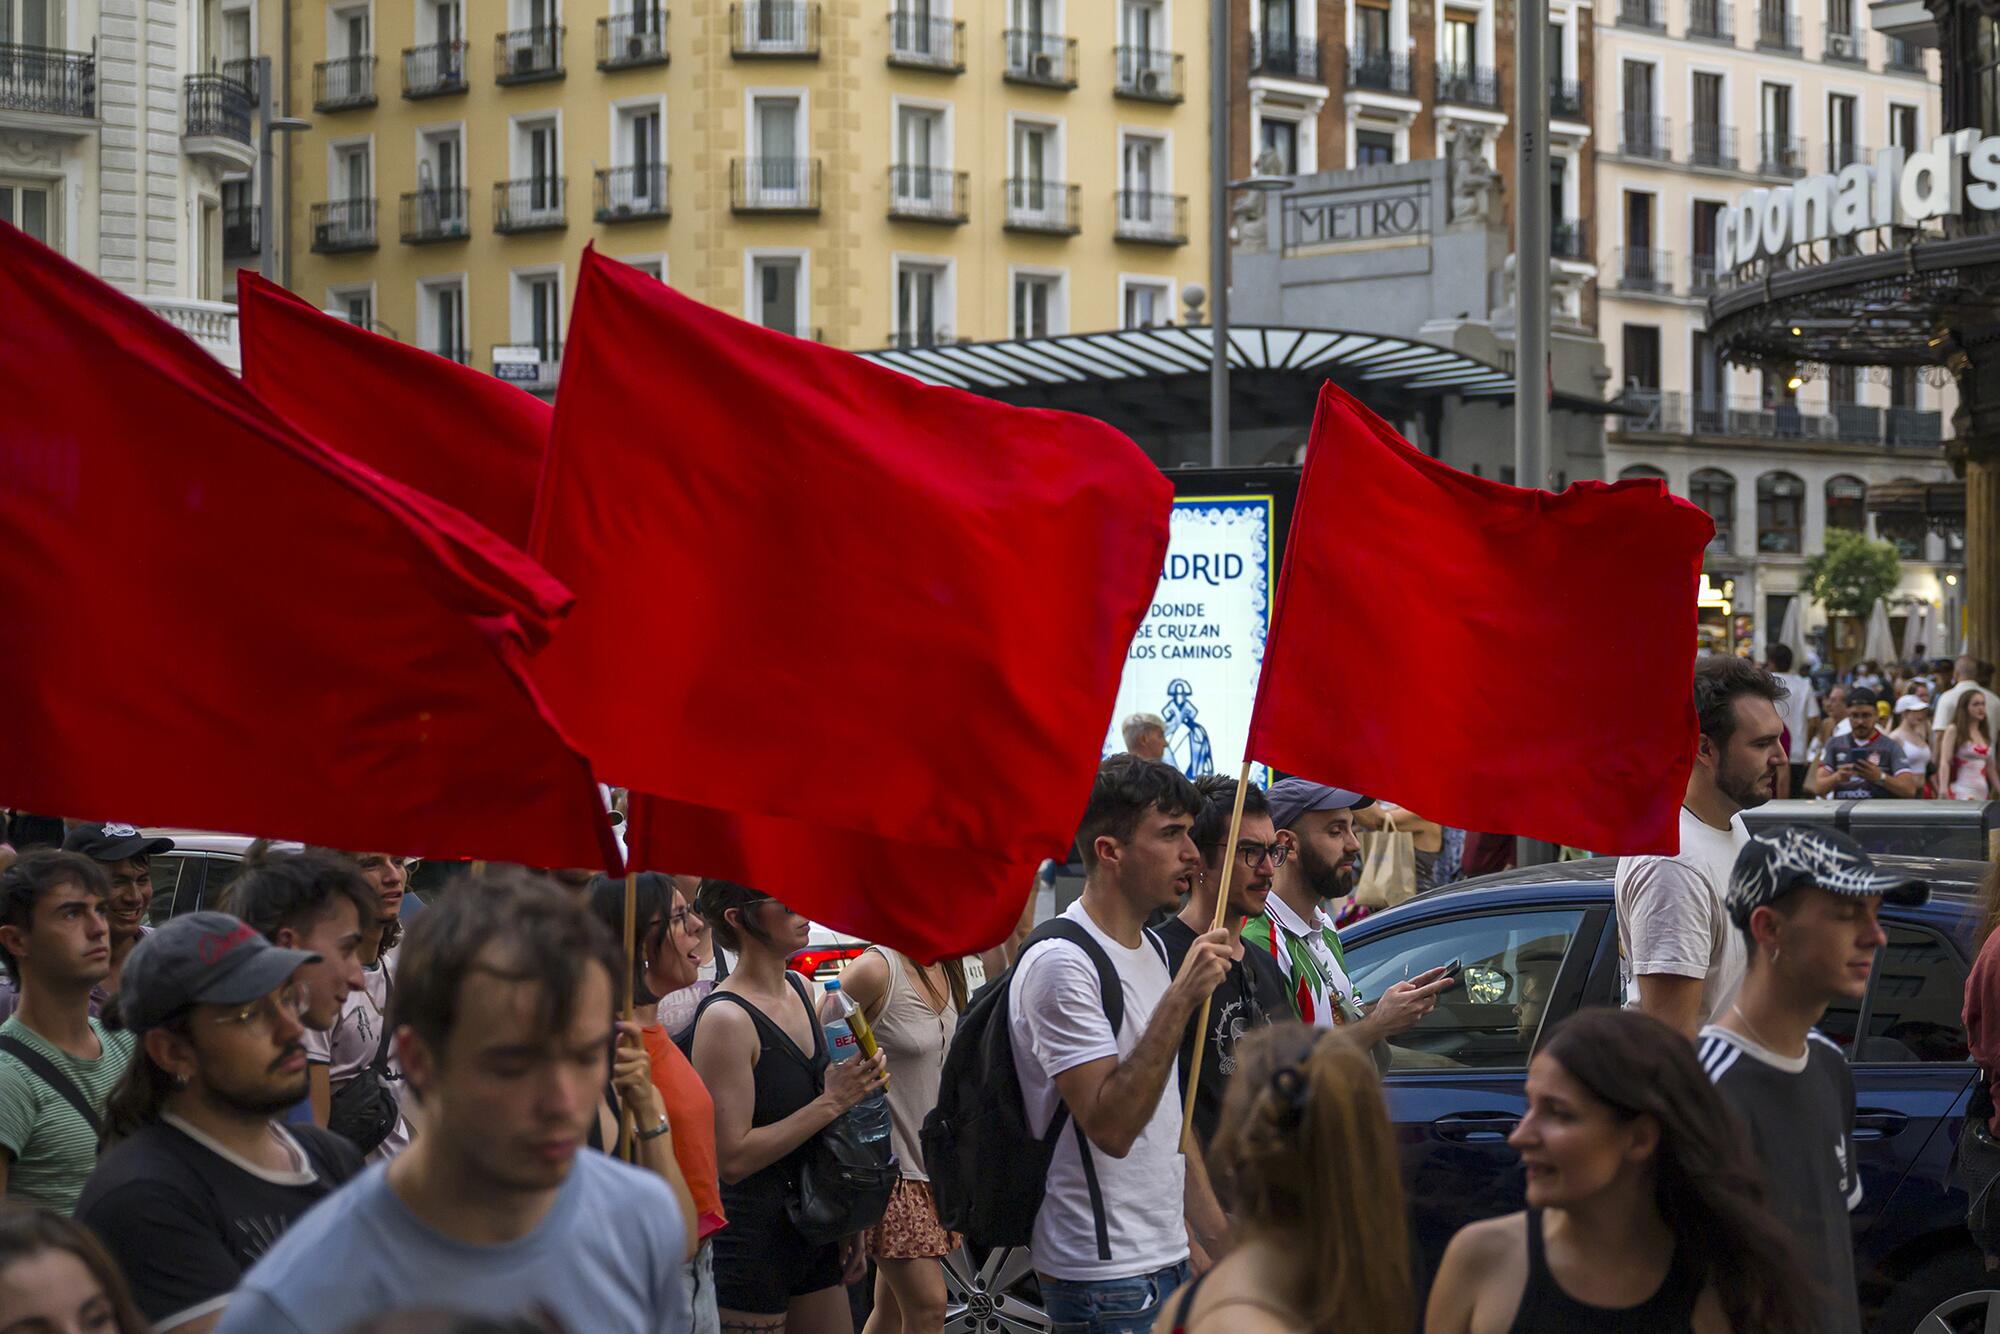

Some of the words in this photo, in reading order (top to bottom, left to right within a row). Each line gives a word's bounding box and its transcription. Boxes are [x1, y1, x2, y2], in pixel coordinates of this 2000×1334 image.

[1715, 127, 2000, 279] cDonald's
[1300, 199, 1419, 240] METRO
[1151, 603, 1205, 617] DONDE
[1137, 624, 1153, 638] SE
[1157, 624, 1220, 641] CRUZAN
[1129, 645, 1156, 659] LOS
[1162, 644, 1232, 659] CAMINOS
